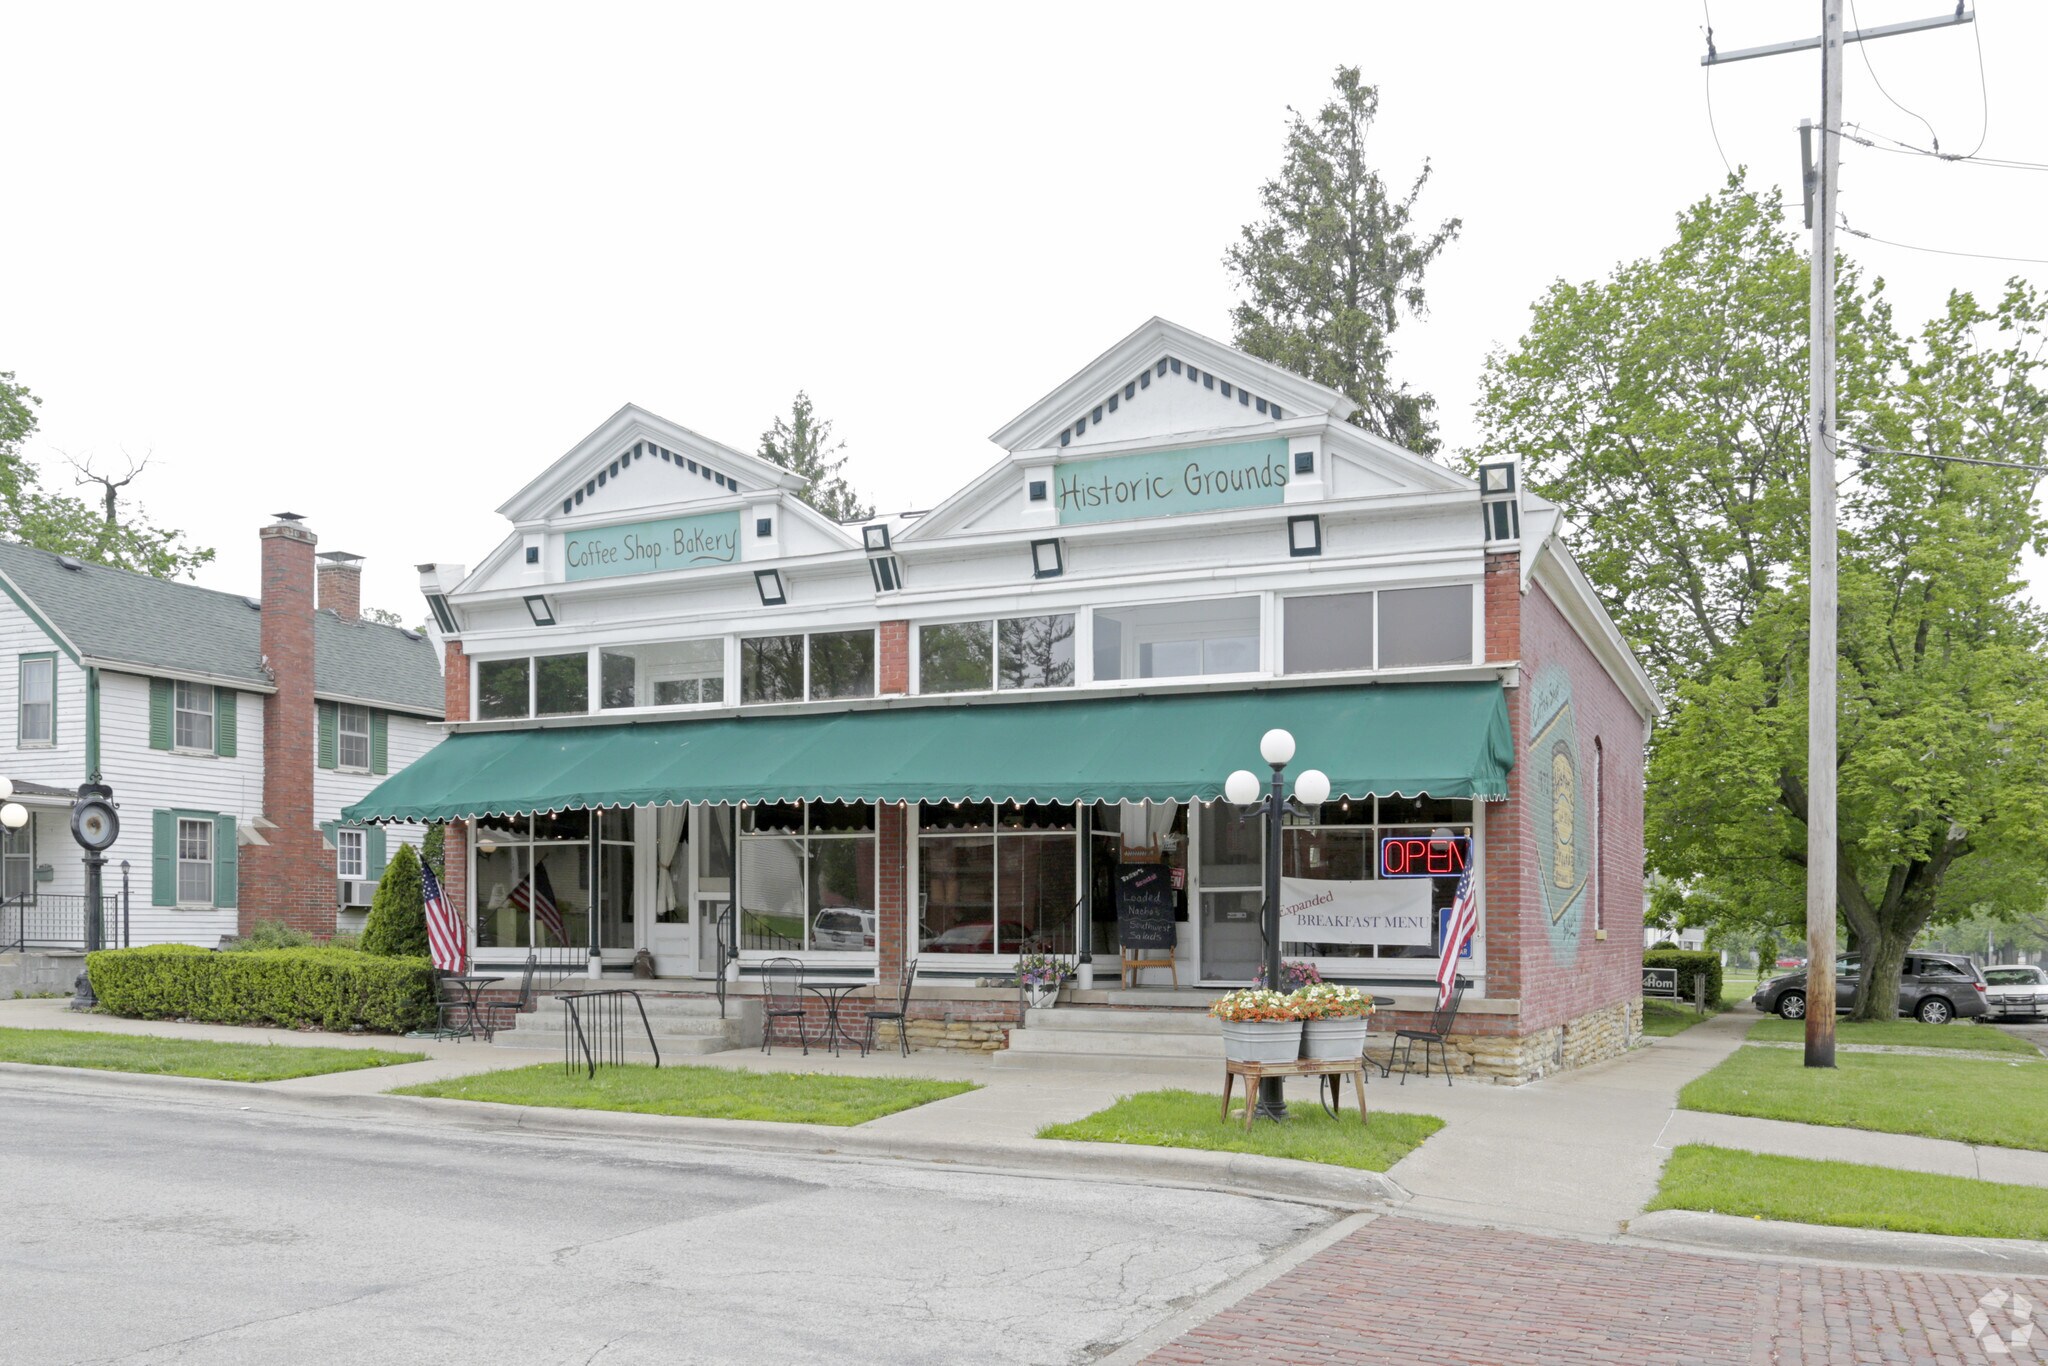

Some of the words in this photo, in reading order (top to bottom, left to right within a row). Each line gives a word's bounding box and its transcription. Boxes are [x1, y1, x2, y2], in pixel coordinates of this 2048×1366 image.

[1060, 472, 1173, 511] Historic
[1184, 454, 1287, 496] Grounds
[567, 540, 618, 568] Coffee
[624, 534, 662, 568] Shop
[1385, 840, 1466, 873] OPEN
[1123, 890, 1161, 903] Loaded
[1280, 889, 1334, 918] Expanded
[1128, 904, 1161, 916] Nachos
[1129, 920, 1172, 932] Southwest
[1297, 914, 1382, 928] BREAKFAST
[1384, 916, 1429, 929] MENU
[1128, 931, 1162, 941] Salads
